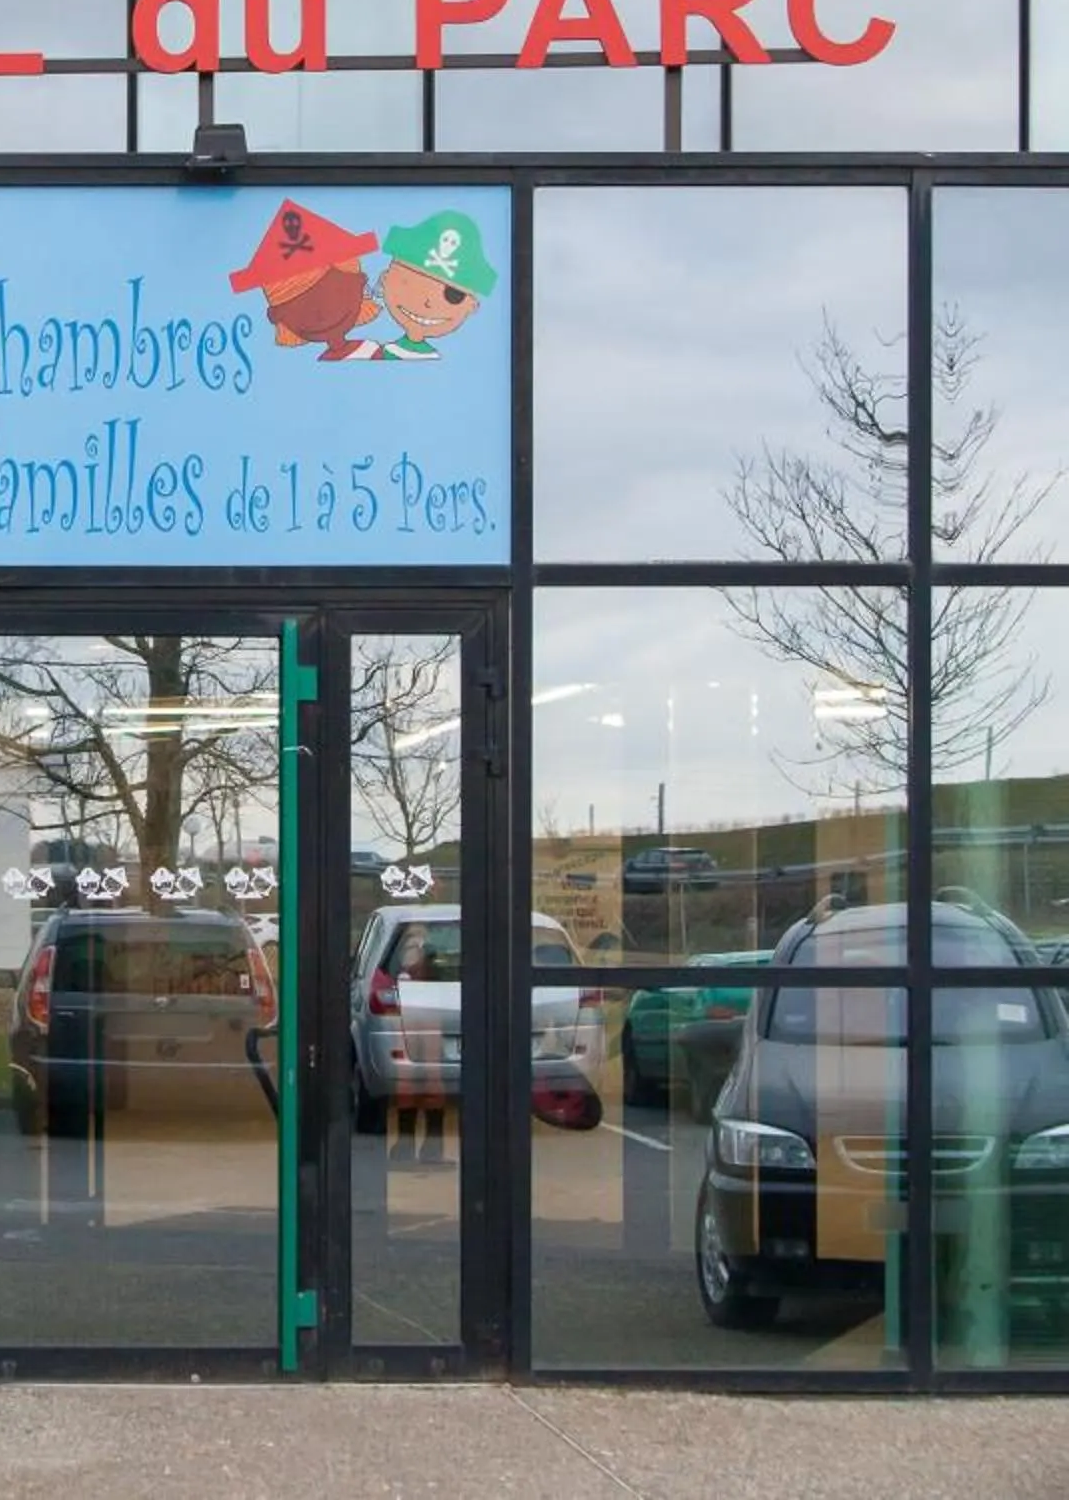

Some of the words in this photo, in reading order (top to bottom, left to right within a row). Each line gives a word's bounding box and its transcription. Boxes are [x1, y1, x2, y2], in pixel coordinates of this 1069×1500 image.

[225, 455, 272, 534] de
[280, 460, 303, 533] 1
[316, 463, 336, 532] à
[350, 454, 379, 532] 5
[390, 450, 497, 536] Pers.
